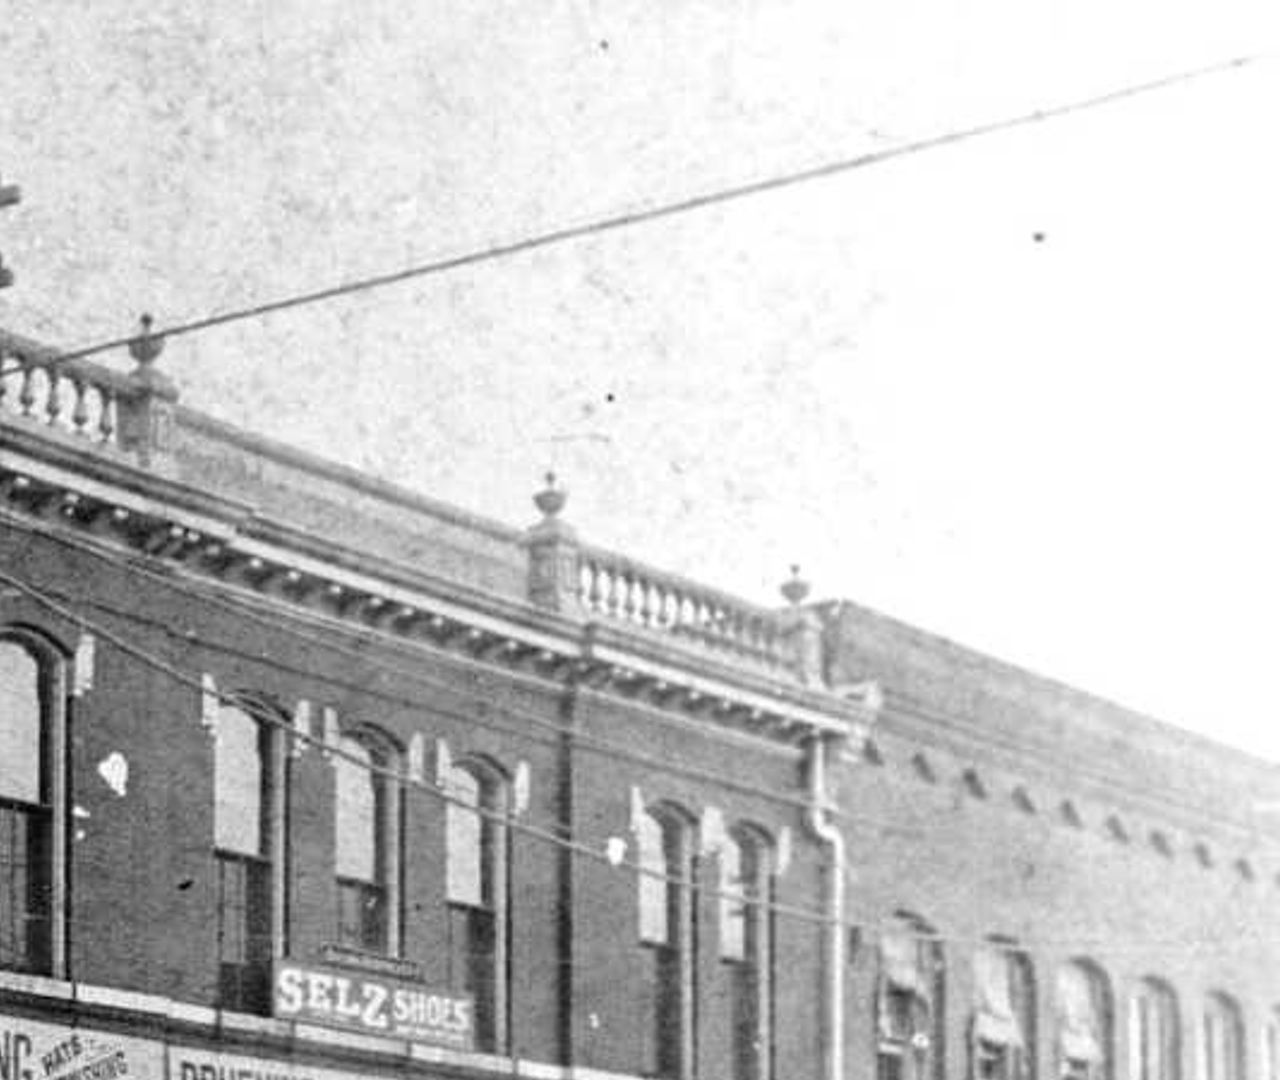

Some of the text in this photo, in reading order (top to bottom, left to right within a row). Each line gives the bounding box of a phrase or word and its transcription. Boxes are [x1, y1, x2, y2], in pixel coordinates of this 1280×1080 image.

[277, 968, 471, 1032] SELZ SHOES
[41, 1033, 83, 1076] HATS
